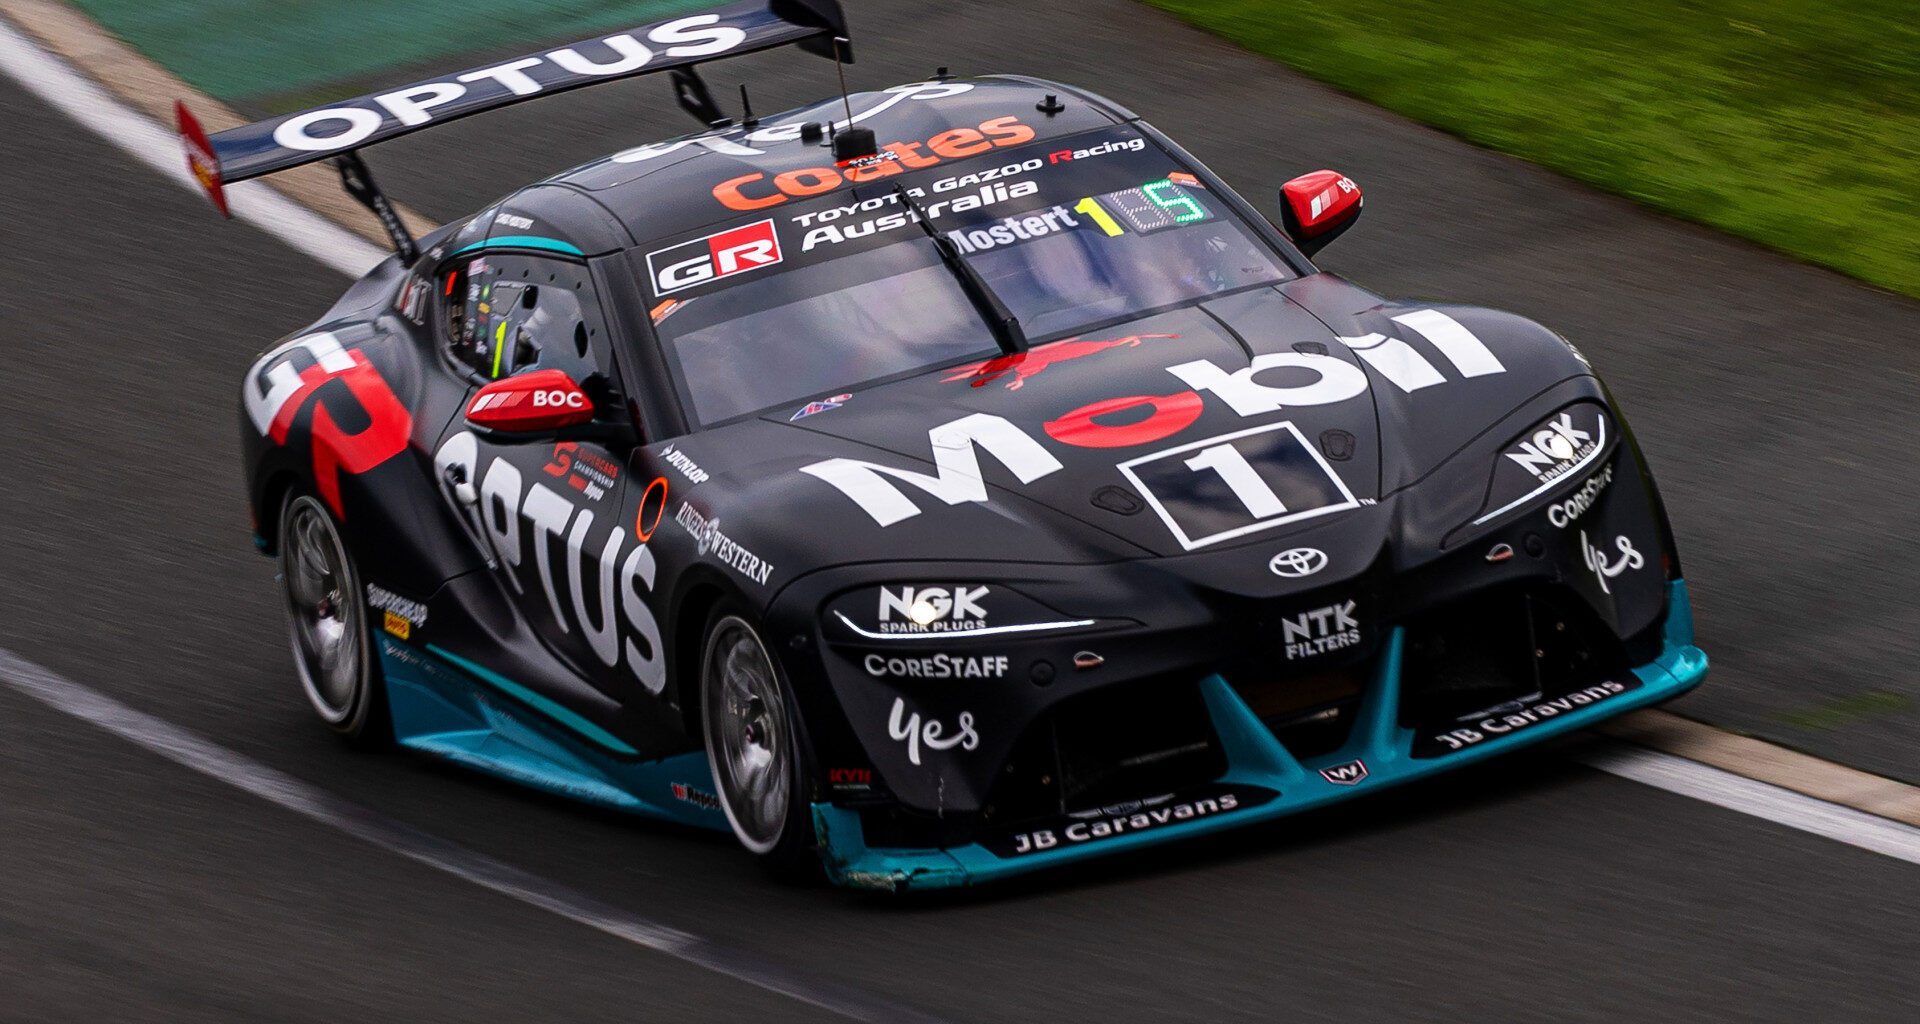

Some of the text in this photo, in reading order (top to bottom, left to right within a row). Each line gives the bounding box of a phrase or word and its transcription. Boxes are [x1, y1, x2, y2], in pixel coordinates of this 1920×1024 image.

[273, 14, 748, 151] OPTUS
[712, 116, 1037, 211] Coates
[792, 187, 926, 228] TOYOTA
[932, 158, 1044, 194] GAZOO
[1049, 138, 1146, 165] Racing
[801, 179, 1039, 252] Australia
[948, 196, 1125, 255] Mostert 1
[658, 239, 777, 290] GR
[533, 390, 583, 408] BOC
[799, 308, 1507, 527] Mobil
[665, 449, 710, 485] DUNLOP
[1505, 412, 1591, 477] NGK
[1183, 442, 1290, 520] 1
[433, 430, 667, 696] OPTUS
[710, 530, 774, 586] WESTERN
[878, 585, 991, 622] NGK
[879, 618, 987, 634] SPARK PLUGS
[1281, 599, 1359, 644] NTK
[1286, 628, 1361, 660] FILTERS
[1437, 678, 1626, 750] JB Caravans
[1014, 793, 1240, 853] JB Caravans
